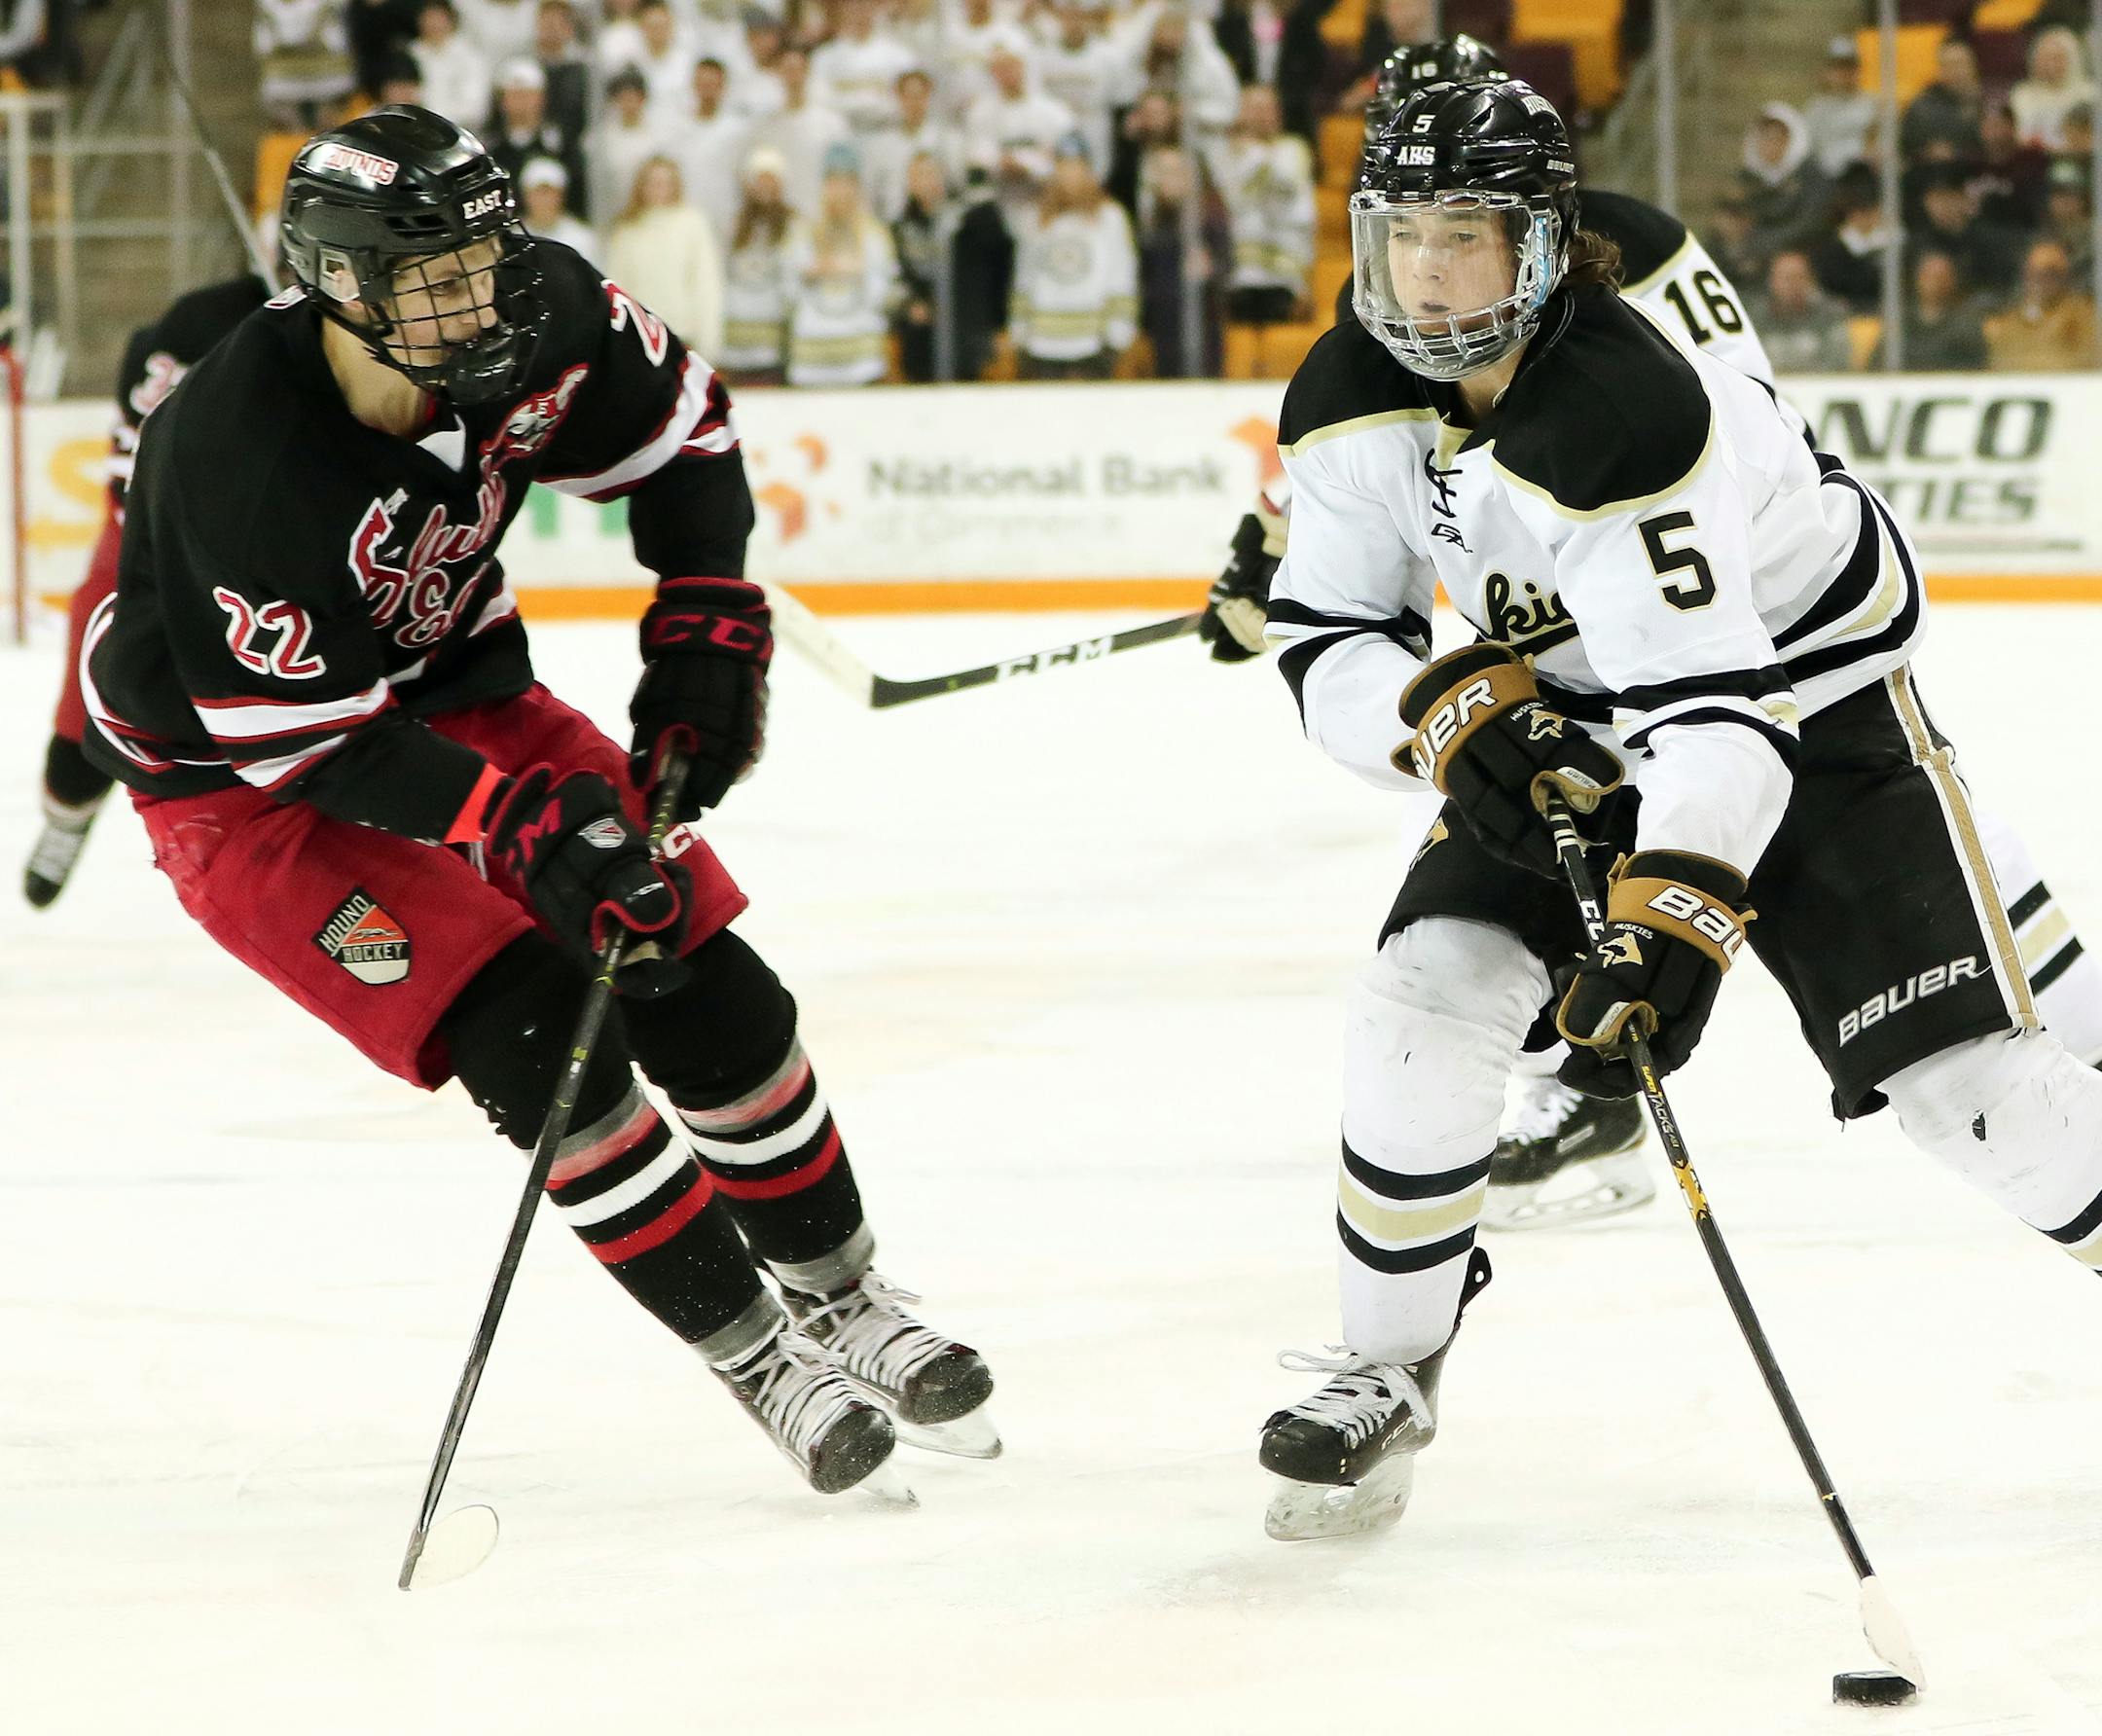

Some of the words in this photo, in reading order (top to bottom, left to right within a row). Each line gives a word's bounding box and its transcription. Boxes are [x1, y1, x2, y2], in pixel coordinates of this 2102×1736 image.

[1411, 61, 1437, 79] 16
[1412, 114, 1436, 133] 5
[1396, 145, 1436, 165] AHS
[462, 189, 502, 220] EAST
[1663, 270, 1743, 344] 16
[1816, 396, 2053, 463] NCO
[866, 453, 1083, 498] National
[1102, 452, 1223, 497] Bank
[1638, 509, 1718, 613] 5
[212, 585, 327, 680] 22
[997, 634, 1113, 683] CCM
[318, 894, 370, 953] HOUND
[1579, 898, 1605, 941] CC
[1613, 922, 1654, 940] HUSKIES
[342, 943, 402, 962] HOCKEY
